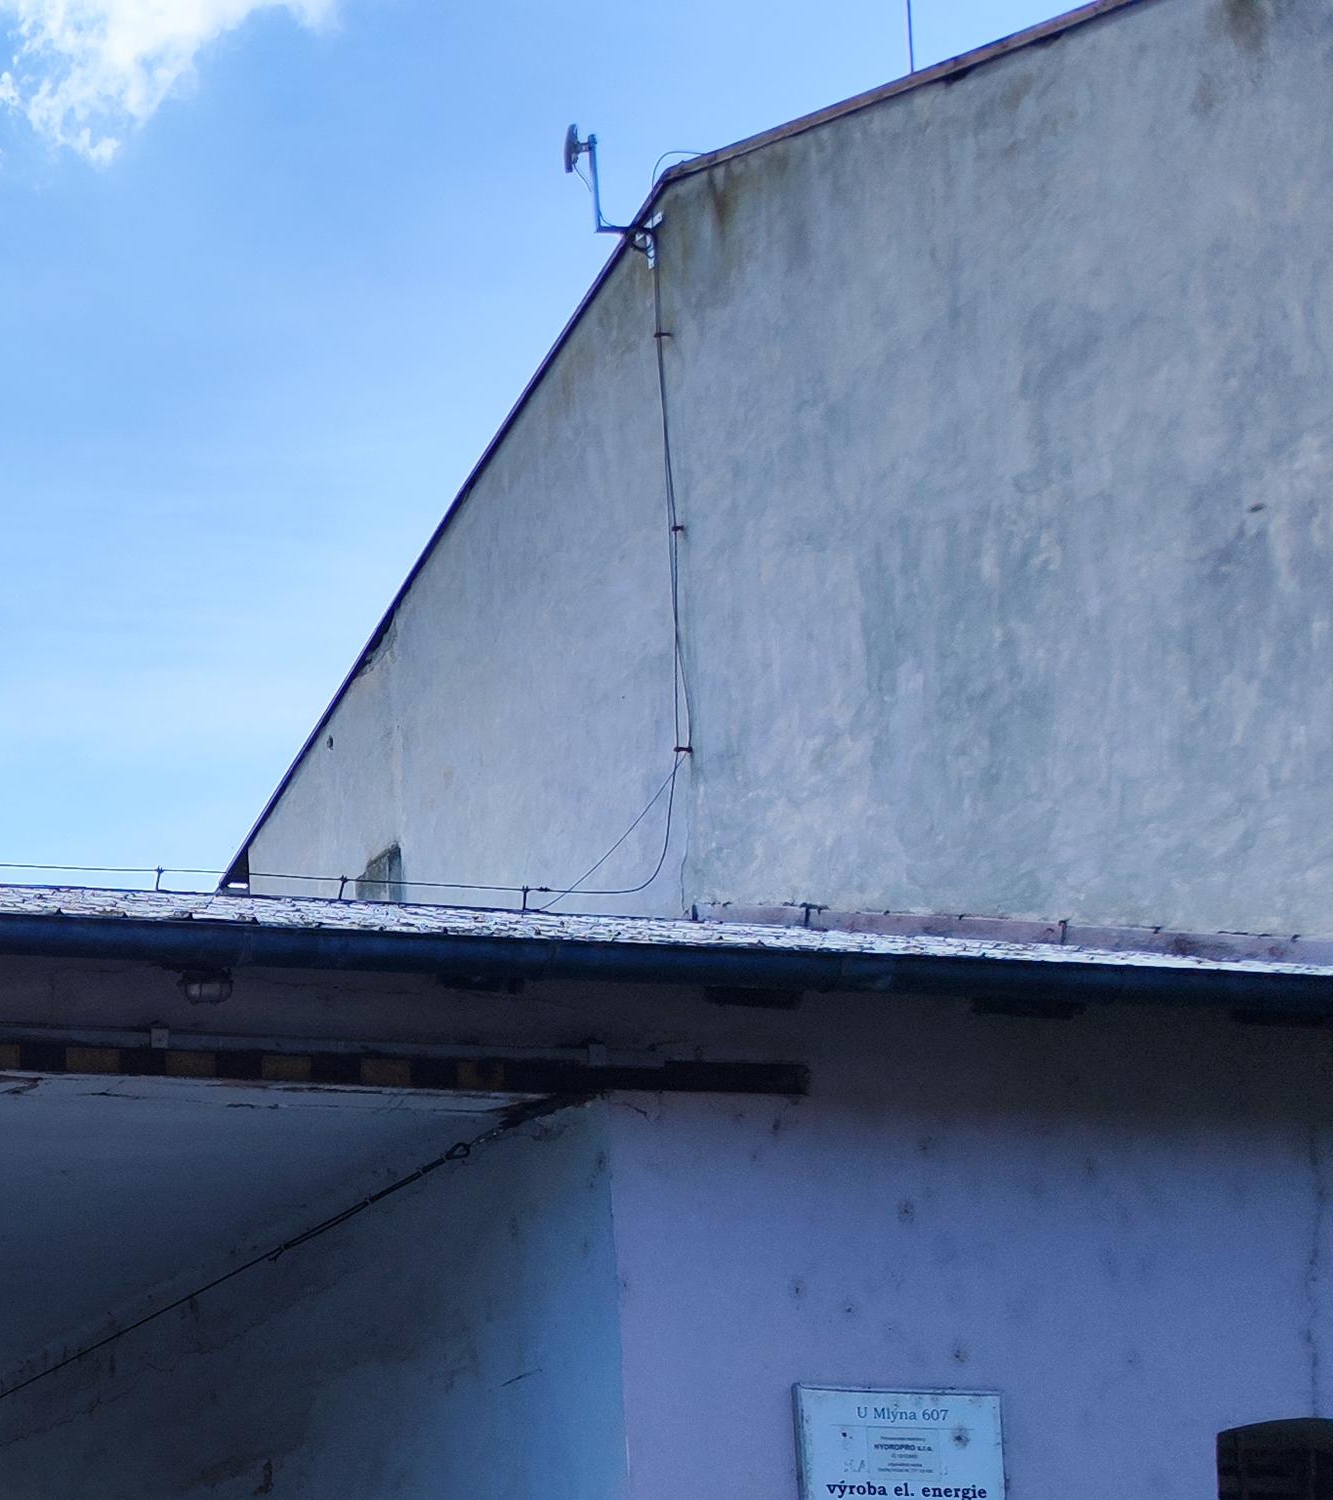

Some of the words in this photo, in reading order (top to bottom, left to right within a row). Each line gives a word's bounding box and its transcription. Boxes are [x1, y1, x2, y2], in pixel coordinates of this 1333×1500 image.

[857, 1407, 868, 1418] U
[873, 1406, 917, 1423] Mlýna
[922, 1409, 949, 1421] 607
[826, 1480, 888, 1498] výroba
[894, 1482, 914, 1497] el.
